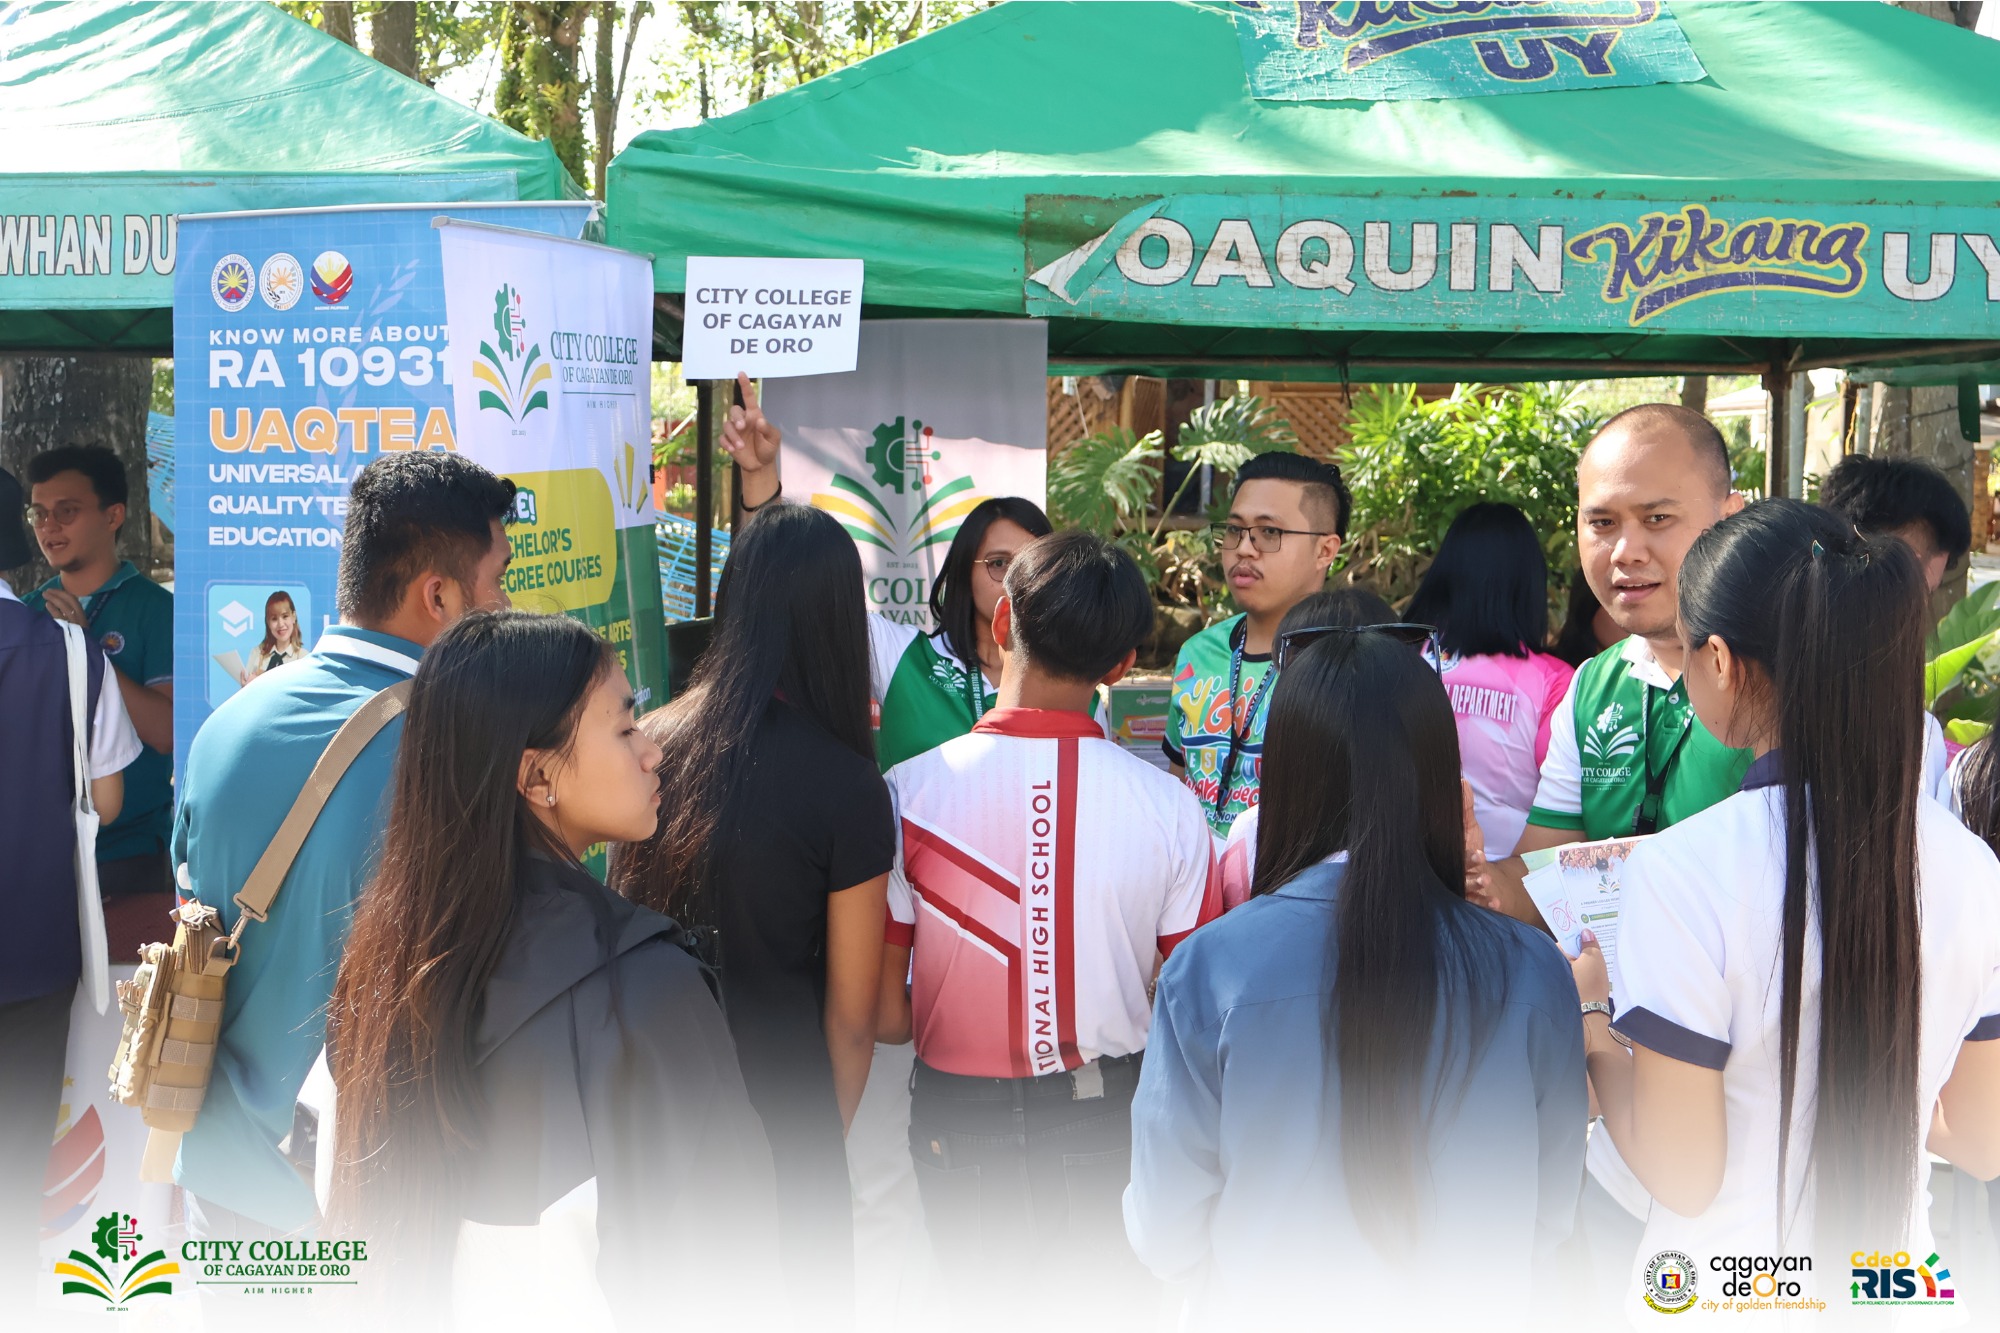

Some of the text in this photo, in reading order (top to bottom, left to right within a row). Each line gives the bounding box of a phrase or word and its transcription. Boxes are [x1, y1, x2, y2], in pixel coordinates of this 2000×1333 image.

[1474, 31, 1621, 83] UY
[0, 215, 112, 276] WHAN
[1115, 217, 1564, 296] OAQUIN
[696, 288, 852, 305] CITY COLLEGE
[209, 325, 449, 345] KNOW MORE ABOUT
[703, 313, 842, 329] OF CAGAYAN
[551, 331, 638, 365] CITY COLLEGE
[730, 338, 813, 354] DE ORO
[209, 346, 454, 388] RA 10931
[563, 367, 573, 383] OF
[576, 367, 609, 384] CAGAYAN
[209, 406, 458, 455] UAQTEA
[208, 463, 348, 484] UNIVERSAL
[208, 495, 315, 515] QUALITY
[1451, 684, 1518, 723] DEPARTMENT
[1031, 780, 1052, 896] SCHOOL
[1033, 907, 1049, 975] HIGH
